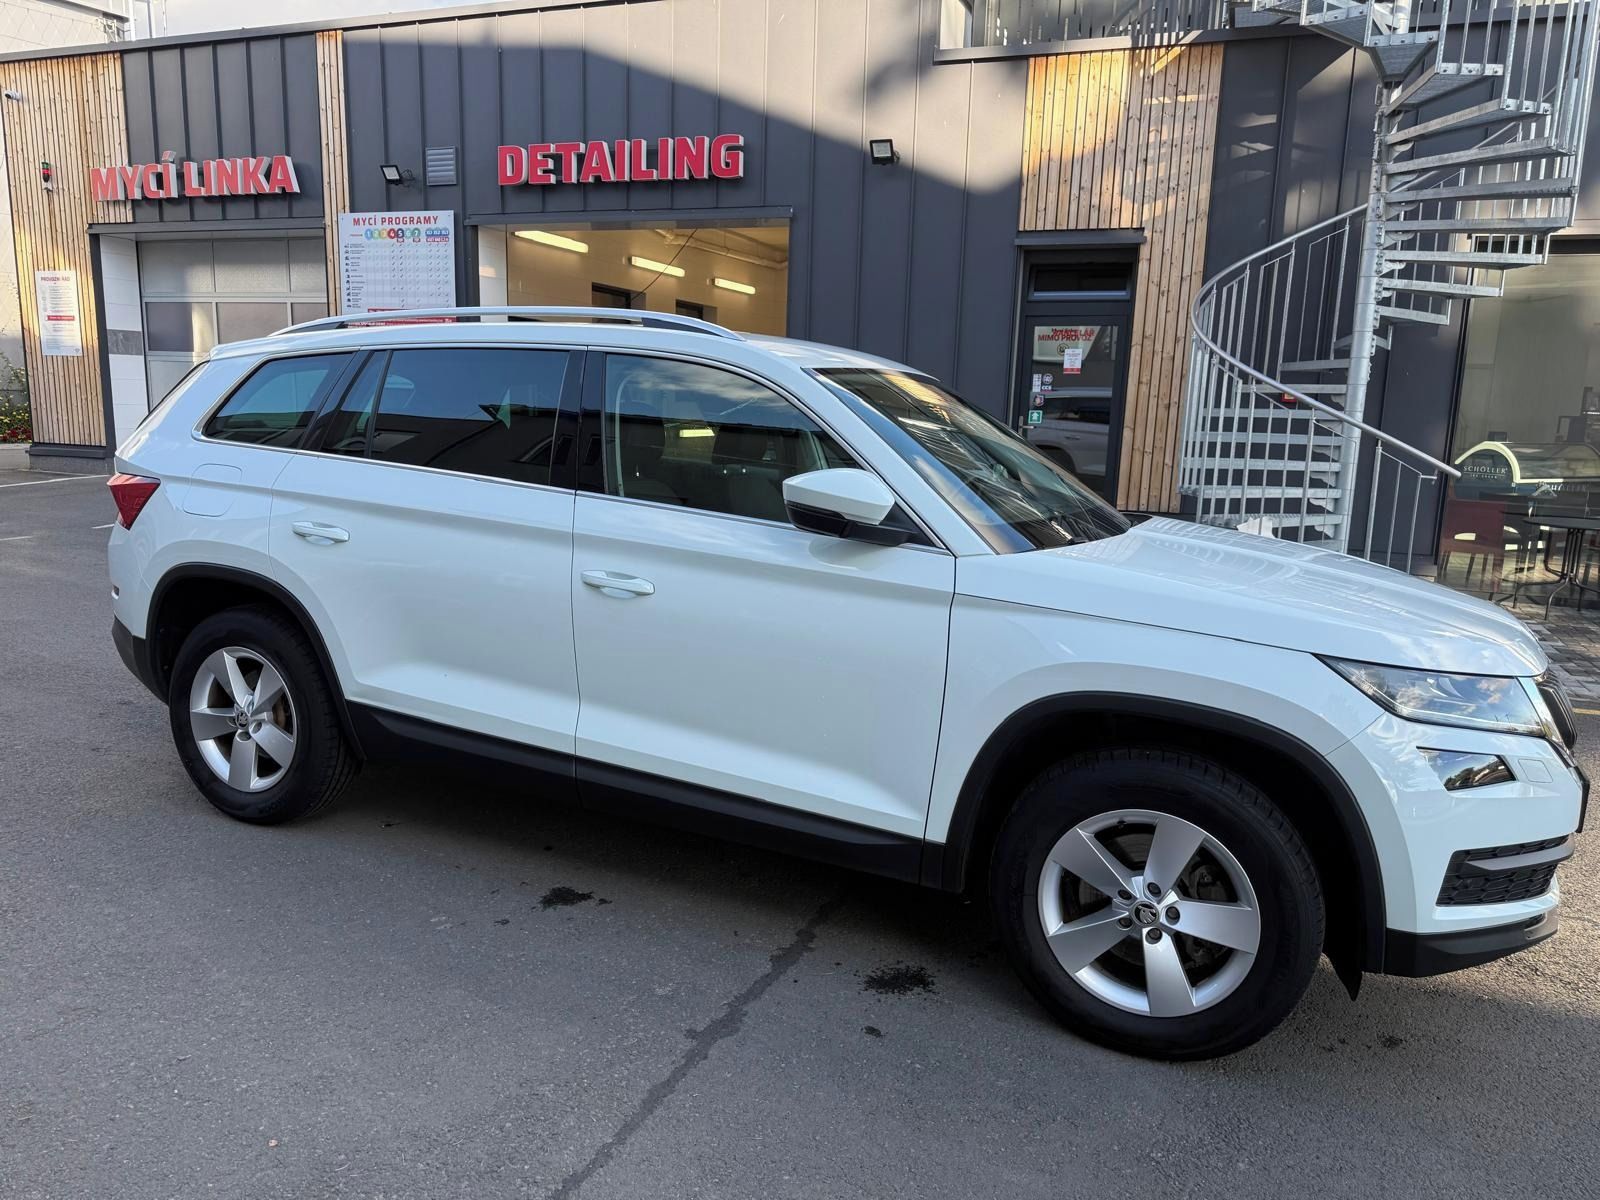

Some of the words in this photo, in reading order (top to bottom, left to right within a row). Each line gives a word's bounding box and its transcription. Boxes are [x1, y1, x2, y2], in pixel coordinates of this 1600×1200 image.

[90, 151, 178, 202] MYCÍ
[184, 155, 301, 198] LINKA
[497, 134, 745, 186] DETAILING
[353, 215, 377, 226] MYCÍ
[381, 215, 438, 226] PROGRAMY
